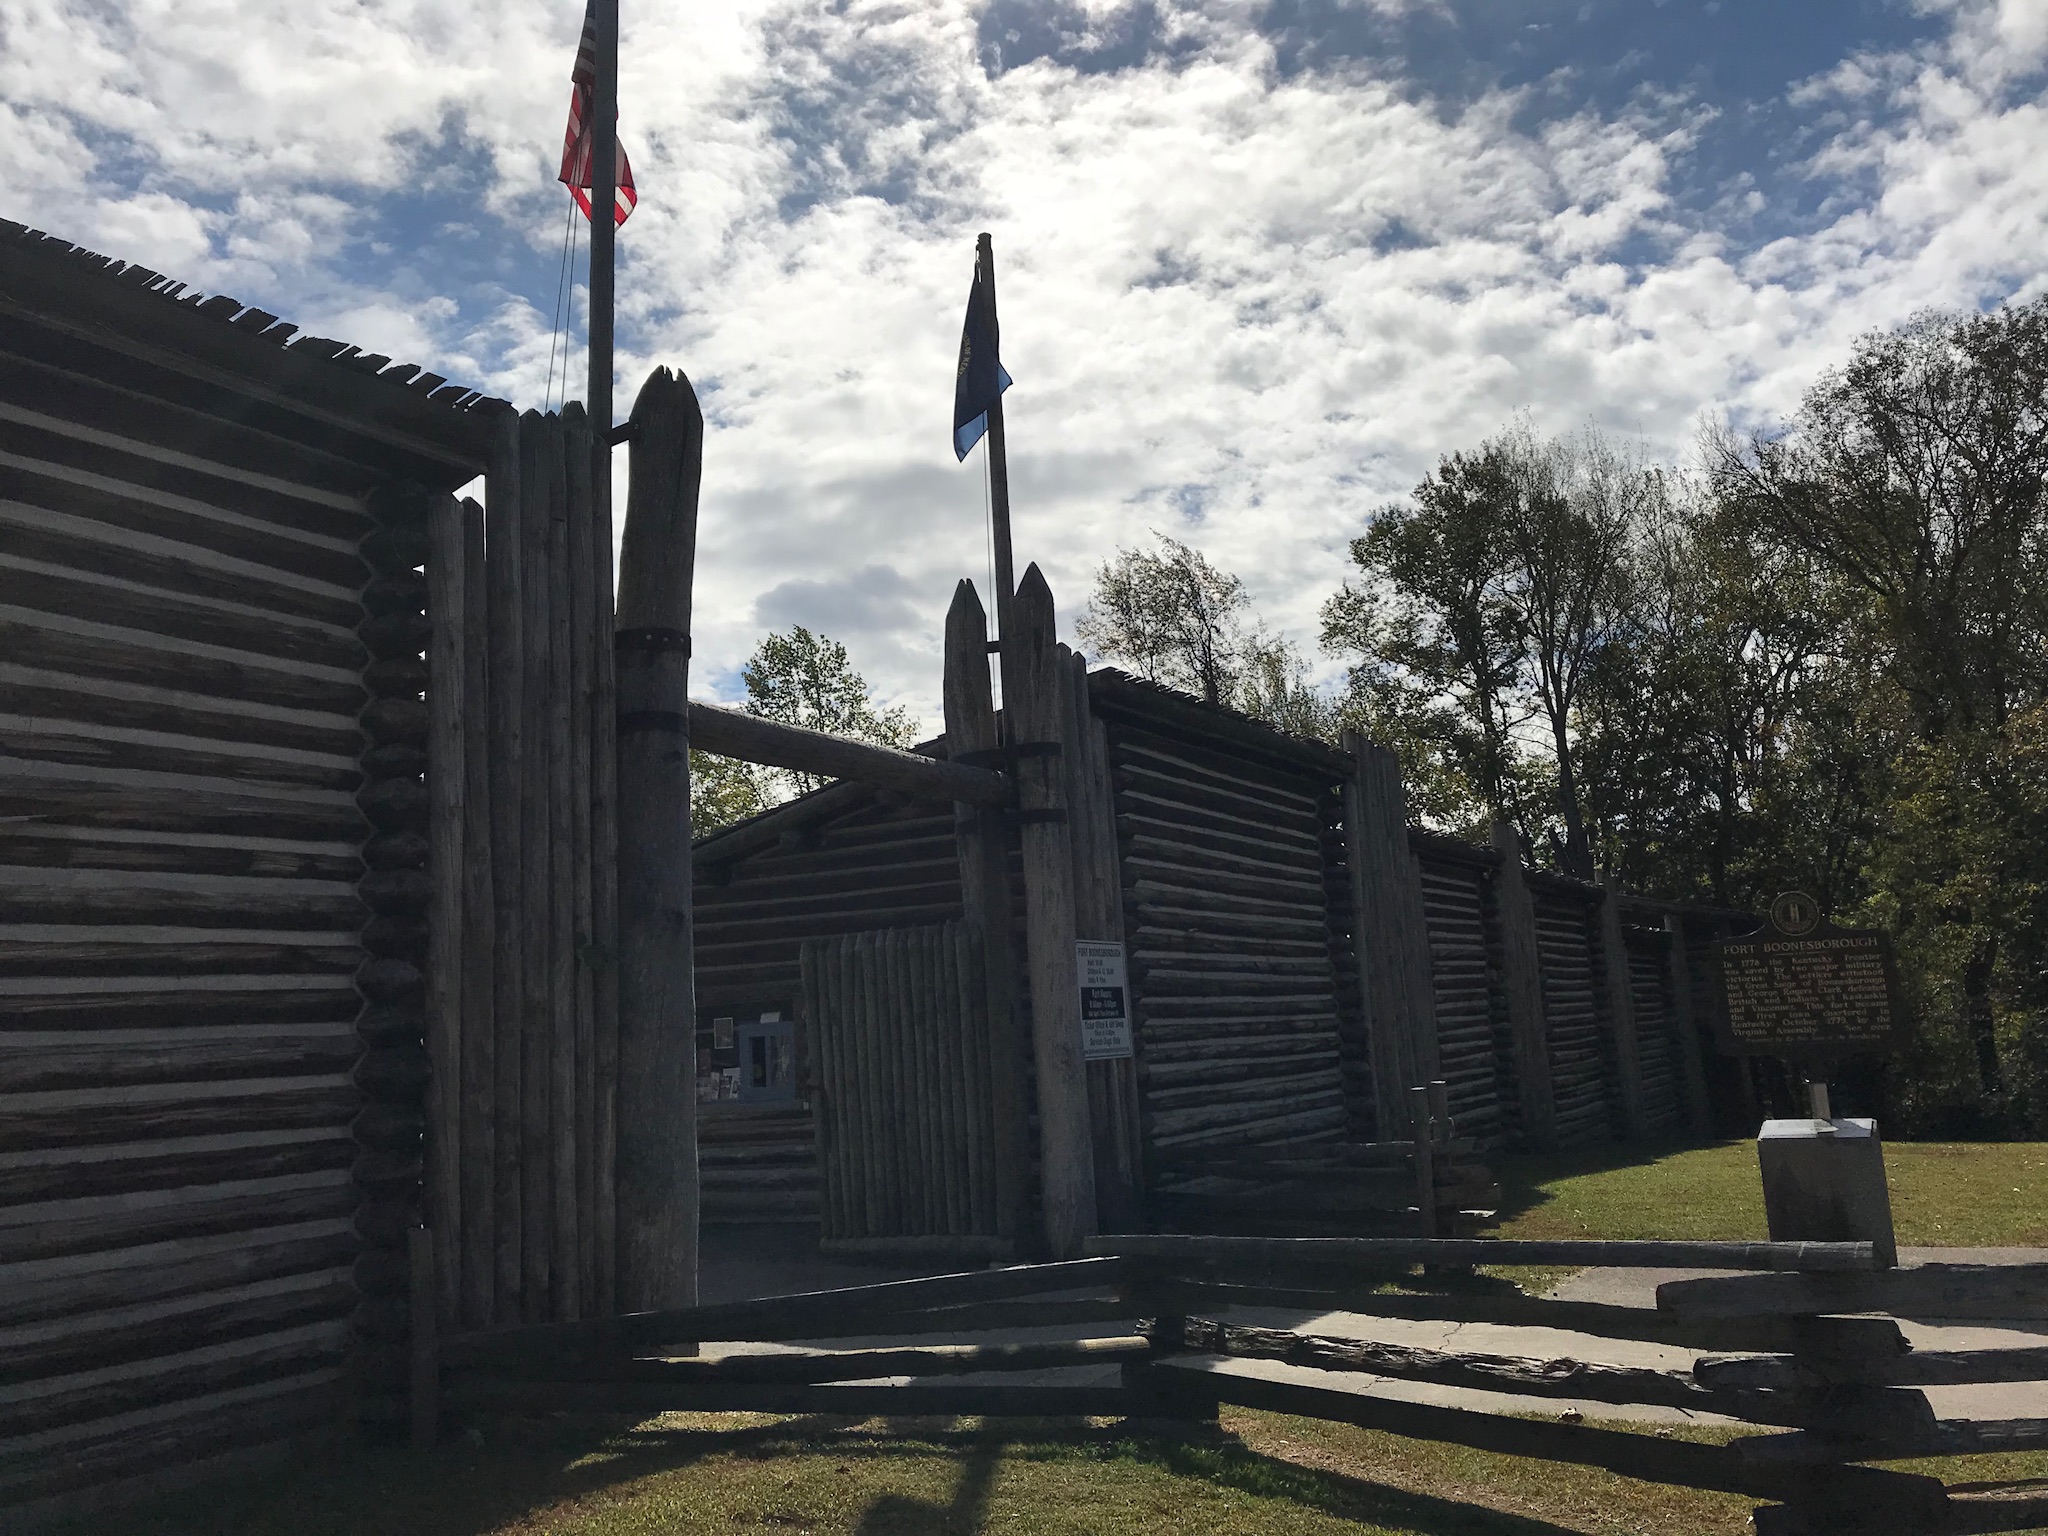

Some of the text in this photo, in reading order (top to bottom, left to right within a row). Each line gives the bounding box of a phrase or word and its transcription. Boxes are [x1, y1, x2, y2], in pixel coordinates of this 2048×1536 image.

[1723, 937, 1878, 955] FORT BOONESBOROUGH
[1723, 953, 1882, 968] In 1778 the Kentucky frontier
[1744, 966, 1769, 975] saved
[1773, 966, 1786, 974] by
[1791, 963, 1808, 972] two
[1813, 962, 1840, 972] major
[1845, 961, 1882, 969] military
[1773, 972, 1792, 981] The
[1839, 968, 1884, 977] withstood
[1726, 983, 1740, 991] the
[1744, 981, 1769, 990] Great
[1802, 978, 1812, 987] of
[1727, 990, 1743, 998] and
[1747, 988, 1779, 998] George
[1783, 987, 1814, 997] Rogers
[1847, 983, 1887, 993] defeated
[1727, 998, 1758, 1006] British
[1764, 996, 1781, 1004] and
[1787, 993, 1819, 1004] Indians
[1729, 1005, 1745, 1013] and
[1803, 1001, 1824, 1011] This
[1830, 1001, 1849, 1009] fort
[1855, 1000, 1889, 1008] became
[1730, 1013, 1745, 1021] the
[1756, 1012, 1777, 1020] first
[1822, 1008, 1867, 1017] chartered
[1876, 1015, 1891, 1023] the
[1732, 1028, 1768, 1037] Virginia
